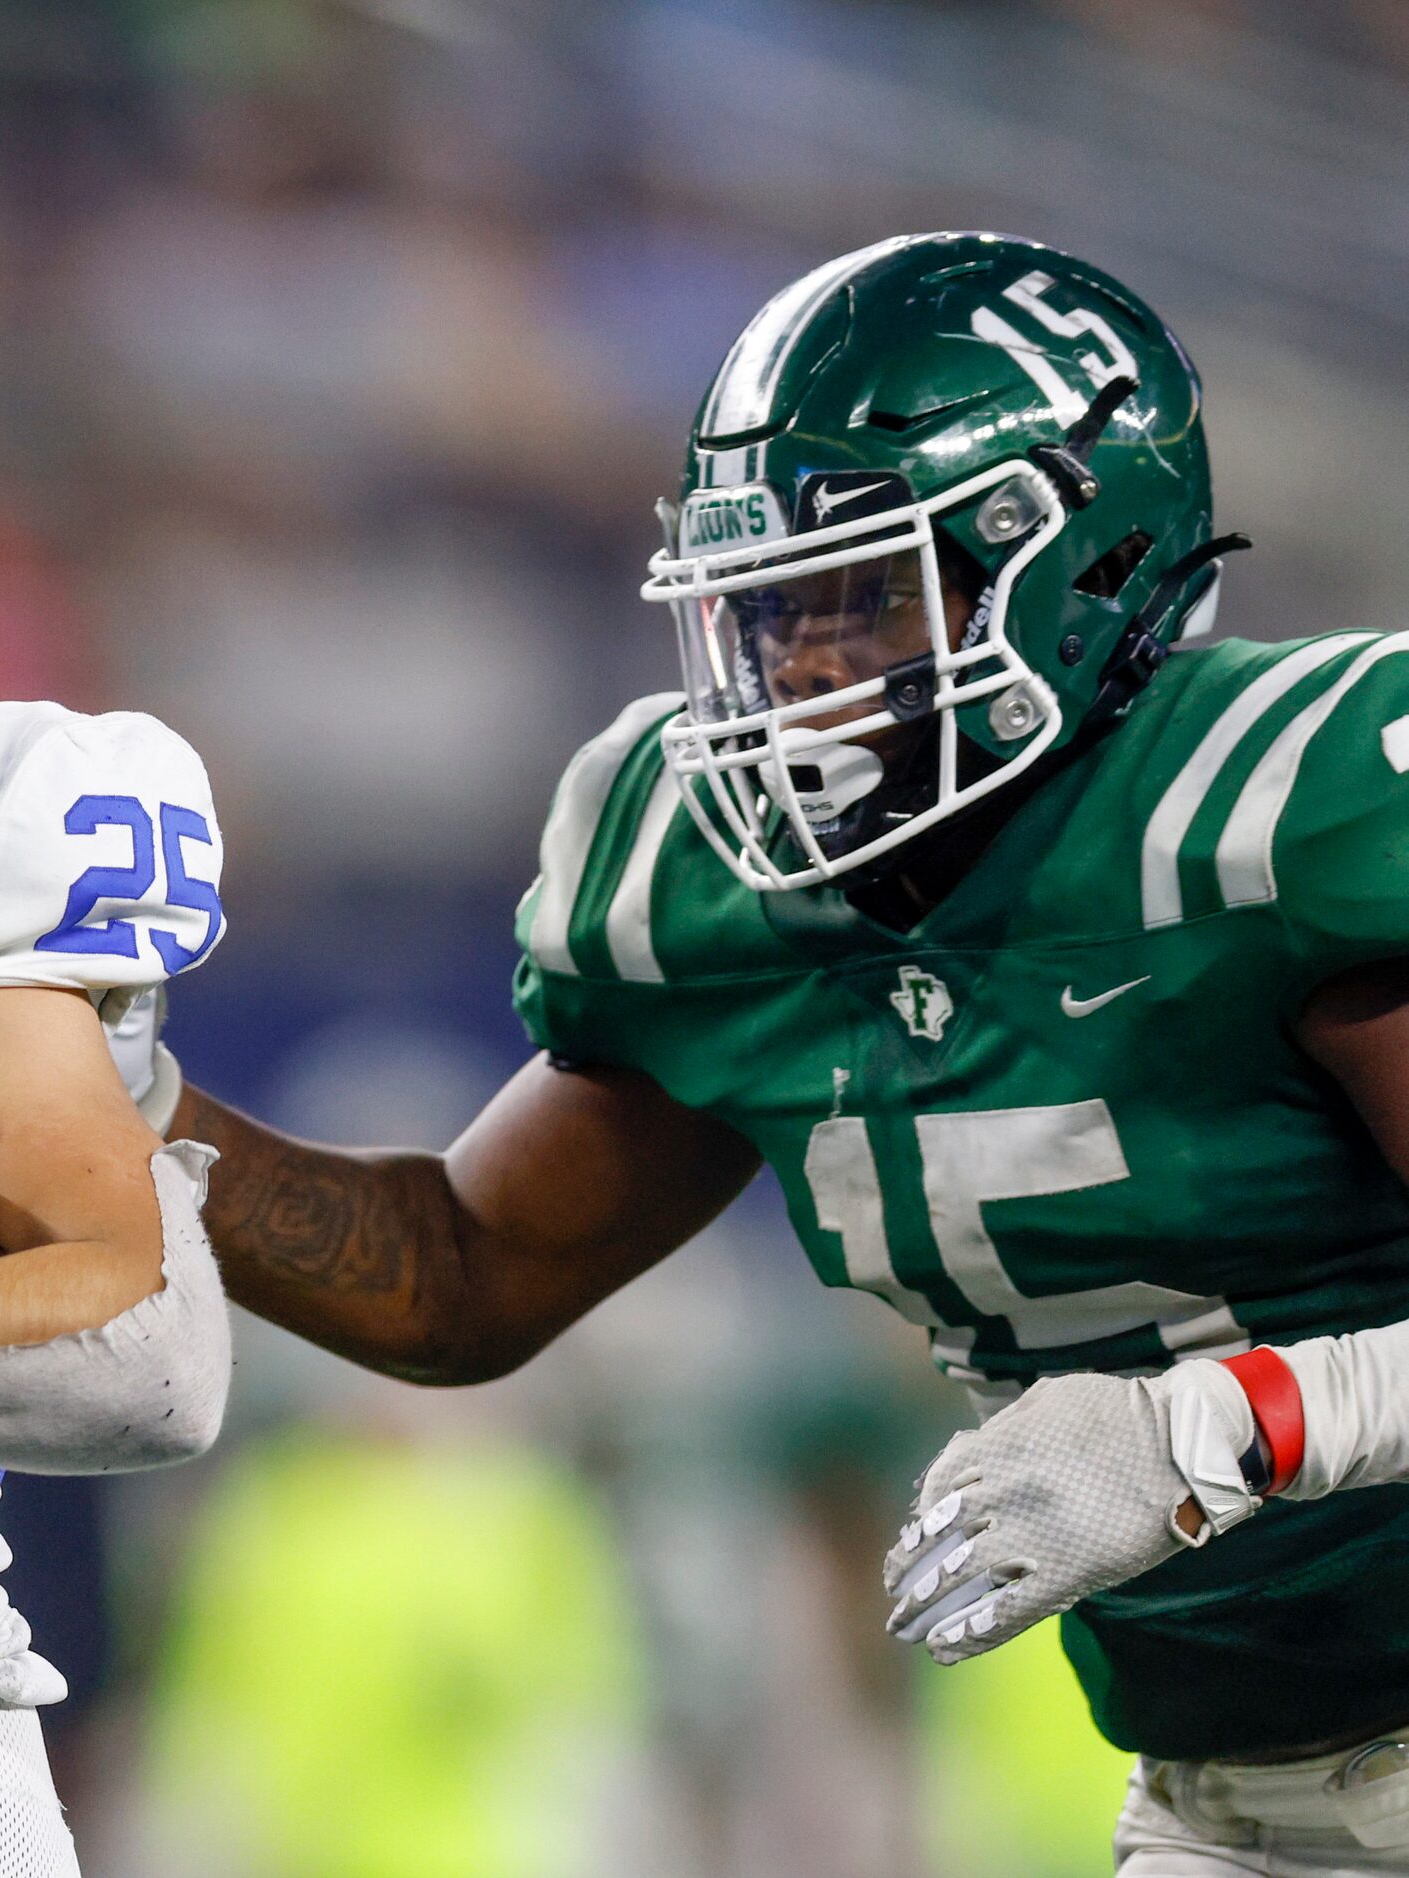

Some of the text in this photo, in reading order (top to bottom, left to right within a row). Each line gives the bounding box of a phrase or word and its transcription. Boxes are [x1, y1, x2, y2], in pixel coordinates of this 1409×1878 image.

[970, 270, 1138, 431] 15
[34, 795, 222, 976] 25
[804, 1098, 1252, 1424] 15
